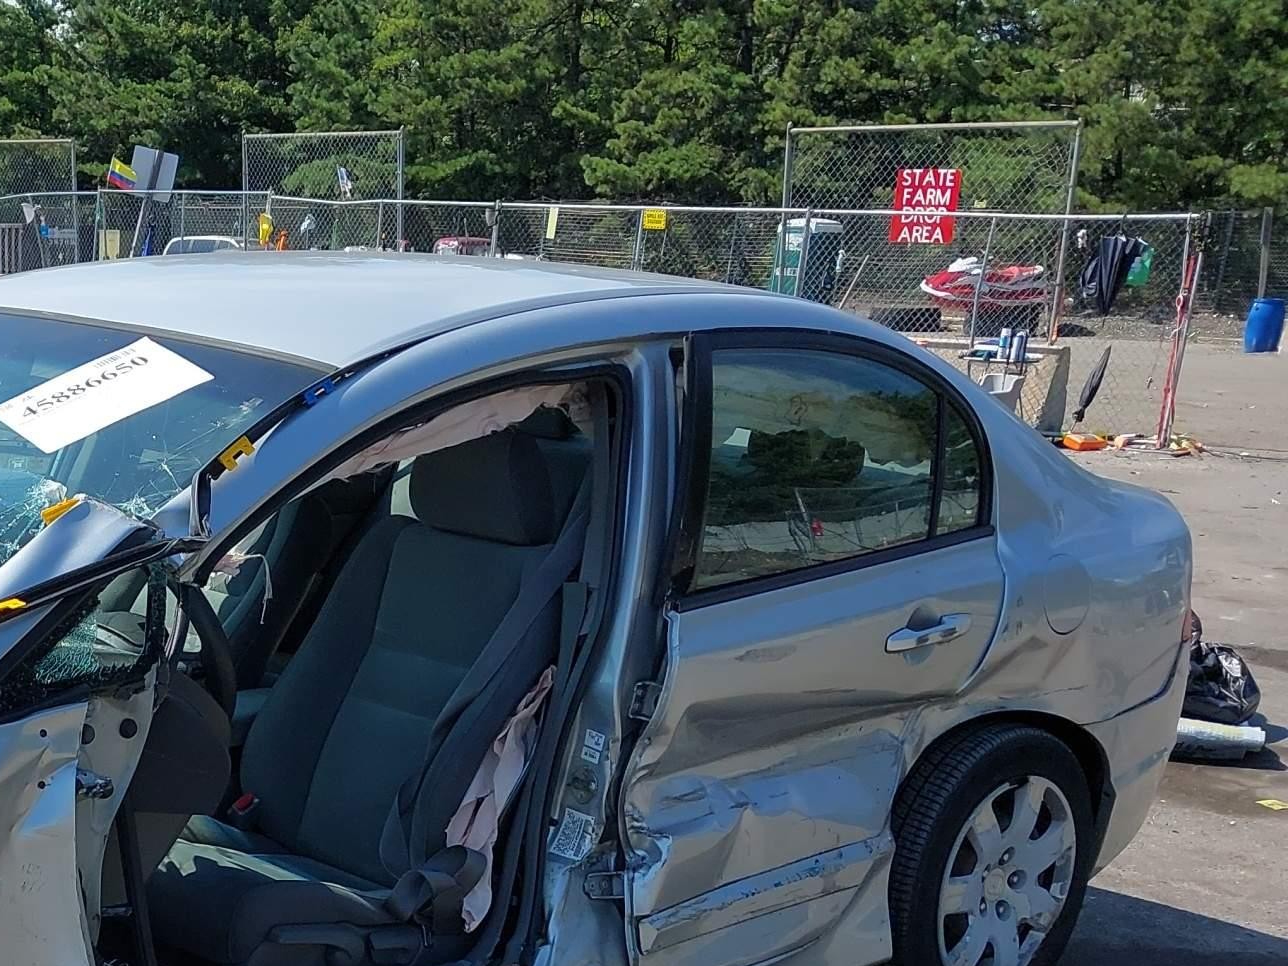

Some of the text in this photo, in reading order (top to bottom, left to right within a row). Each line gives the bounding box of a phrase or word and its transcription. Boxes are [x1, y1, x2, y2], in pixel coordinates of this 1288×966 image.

[901, 168, 957, 187] STATE
[902, 188, 952, 206] FARM
[900, 206, 948, 224] DROP
[897, 225, 944, 243] AREA
[21, 355, 149, 418] 45886650
